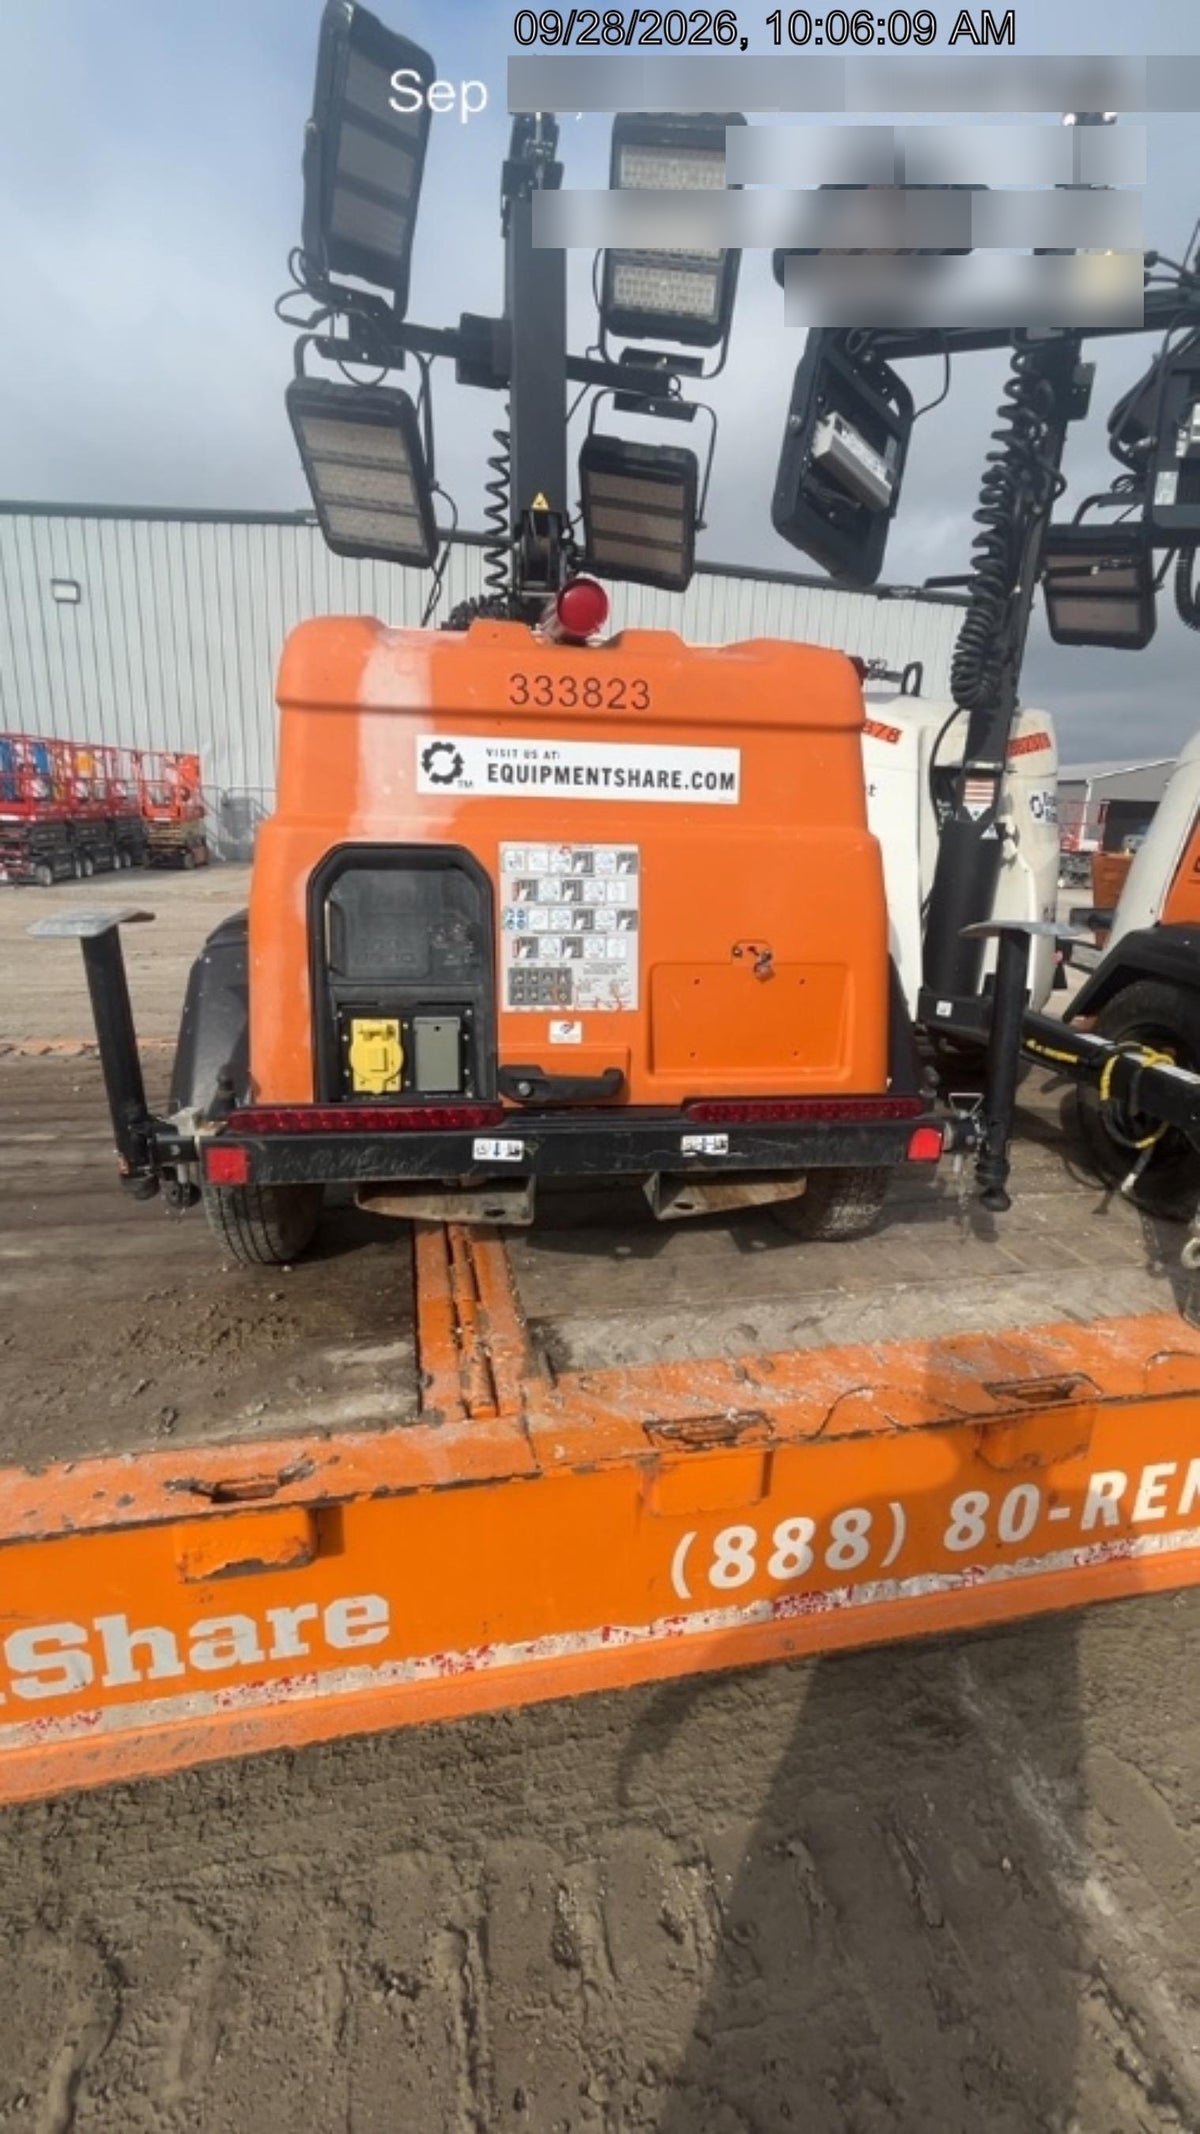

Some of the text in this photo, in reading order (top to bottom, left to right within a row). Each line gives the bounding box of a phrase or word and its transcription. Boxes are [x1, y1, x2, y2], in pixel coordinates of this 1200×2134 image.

[508, 672, 651, 711] 333823
[486, 748, 518, 759] VISIT
[523, 749, 539, 760] US
[487, 762, 736, 791] EQUIPMENTSHARE.COM
[670, 1502, 907, 1599] (888)
[0, 1594, 390, 1699] Share
